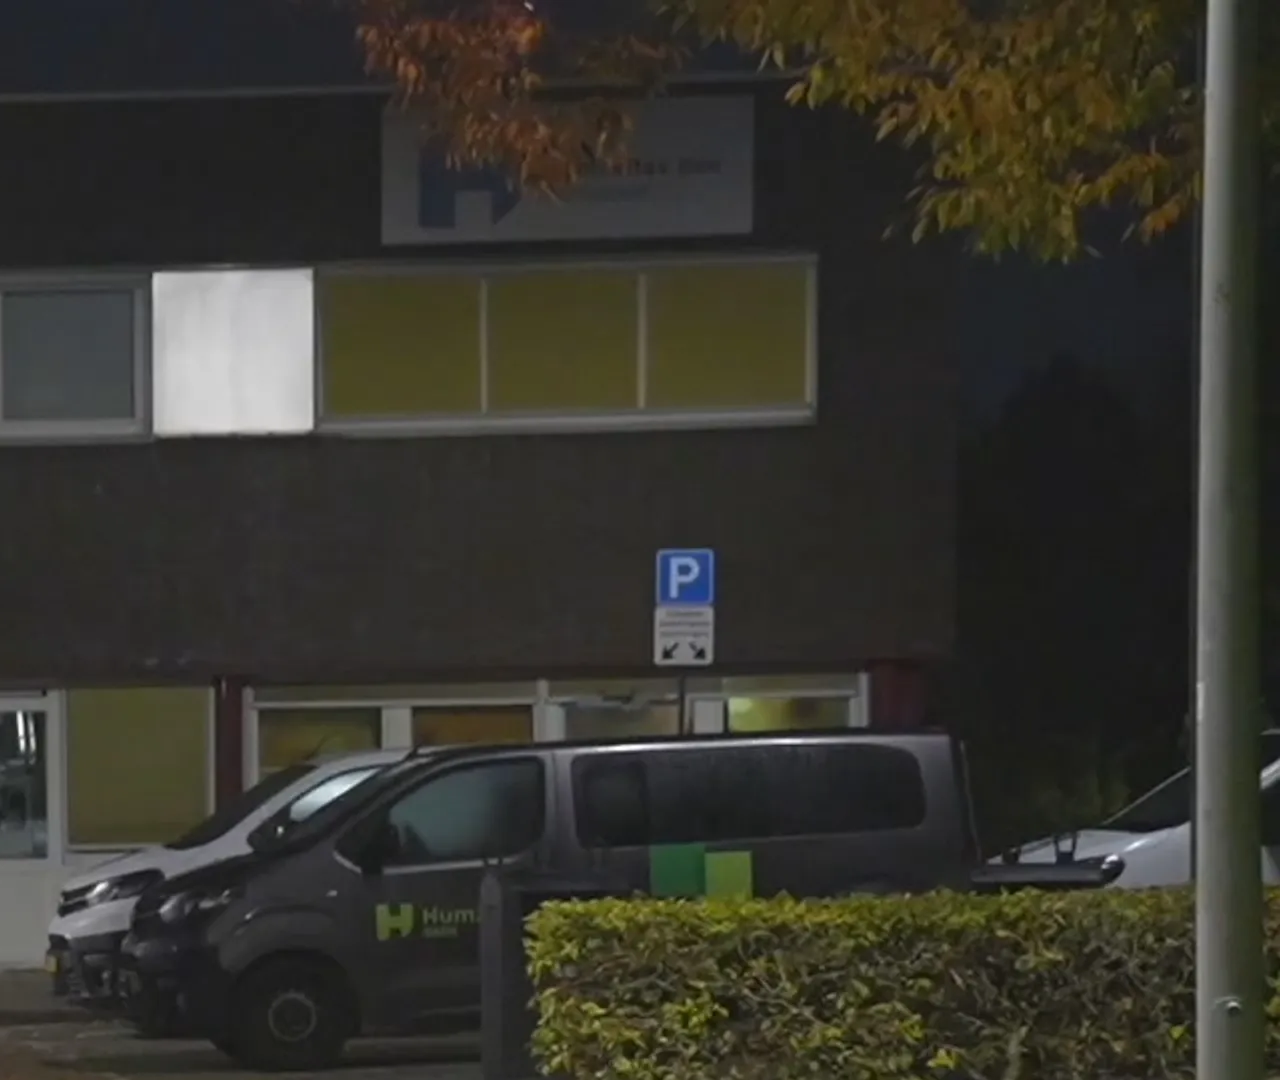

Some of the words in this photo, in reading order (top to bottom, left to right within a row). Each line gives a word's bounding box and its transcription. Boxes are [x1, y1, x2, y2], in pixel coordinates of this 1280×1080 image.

[669, 556, 700, 599] P
[375, 902, 414, 942] H
[422, 907, 481, 924] Hum
